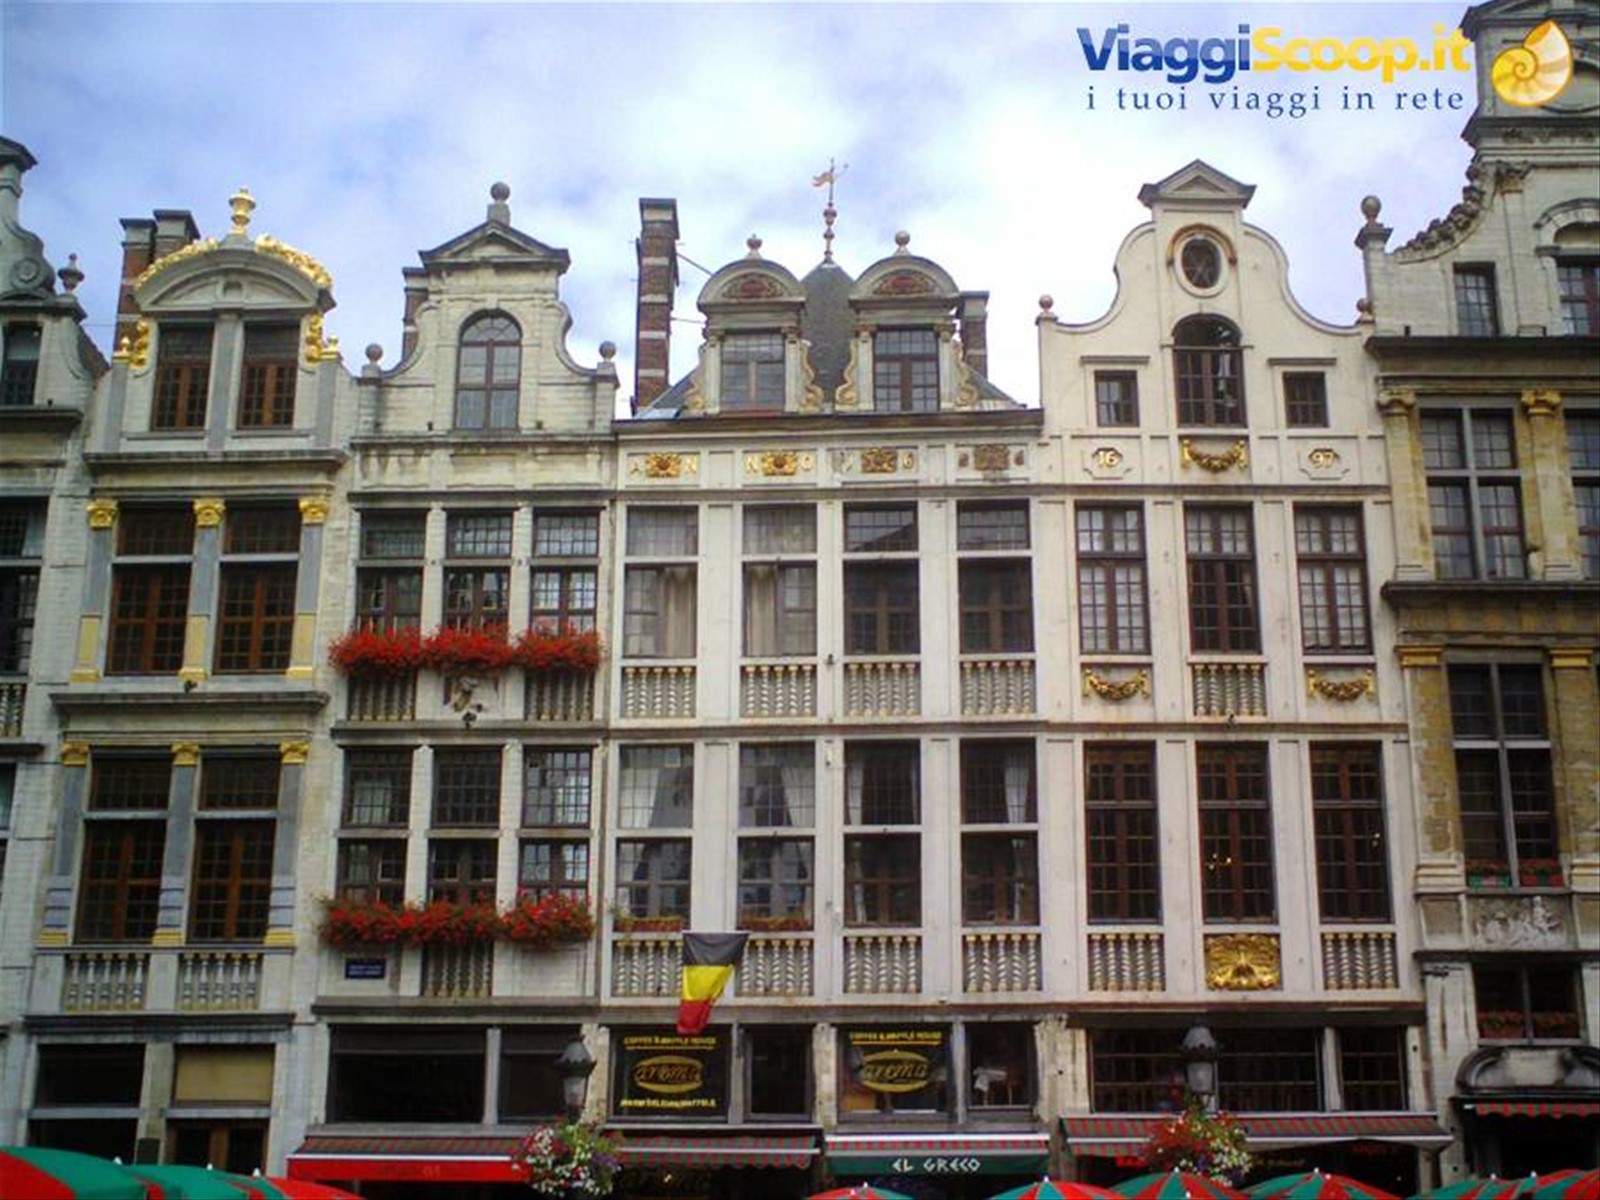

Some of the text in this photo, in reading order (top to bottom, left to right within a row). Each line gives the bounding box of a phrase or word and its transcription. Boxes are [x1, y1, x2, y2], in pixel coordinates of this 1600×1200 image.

[1098, 450, 1335, 469] 16 97
[892, 1157, 982, 1172] EL GRECO
